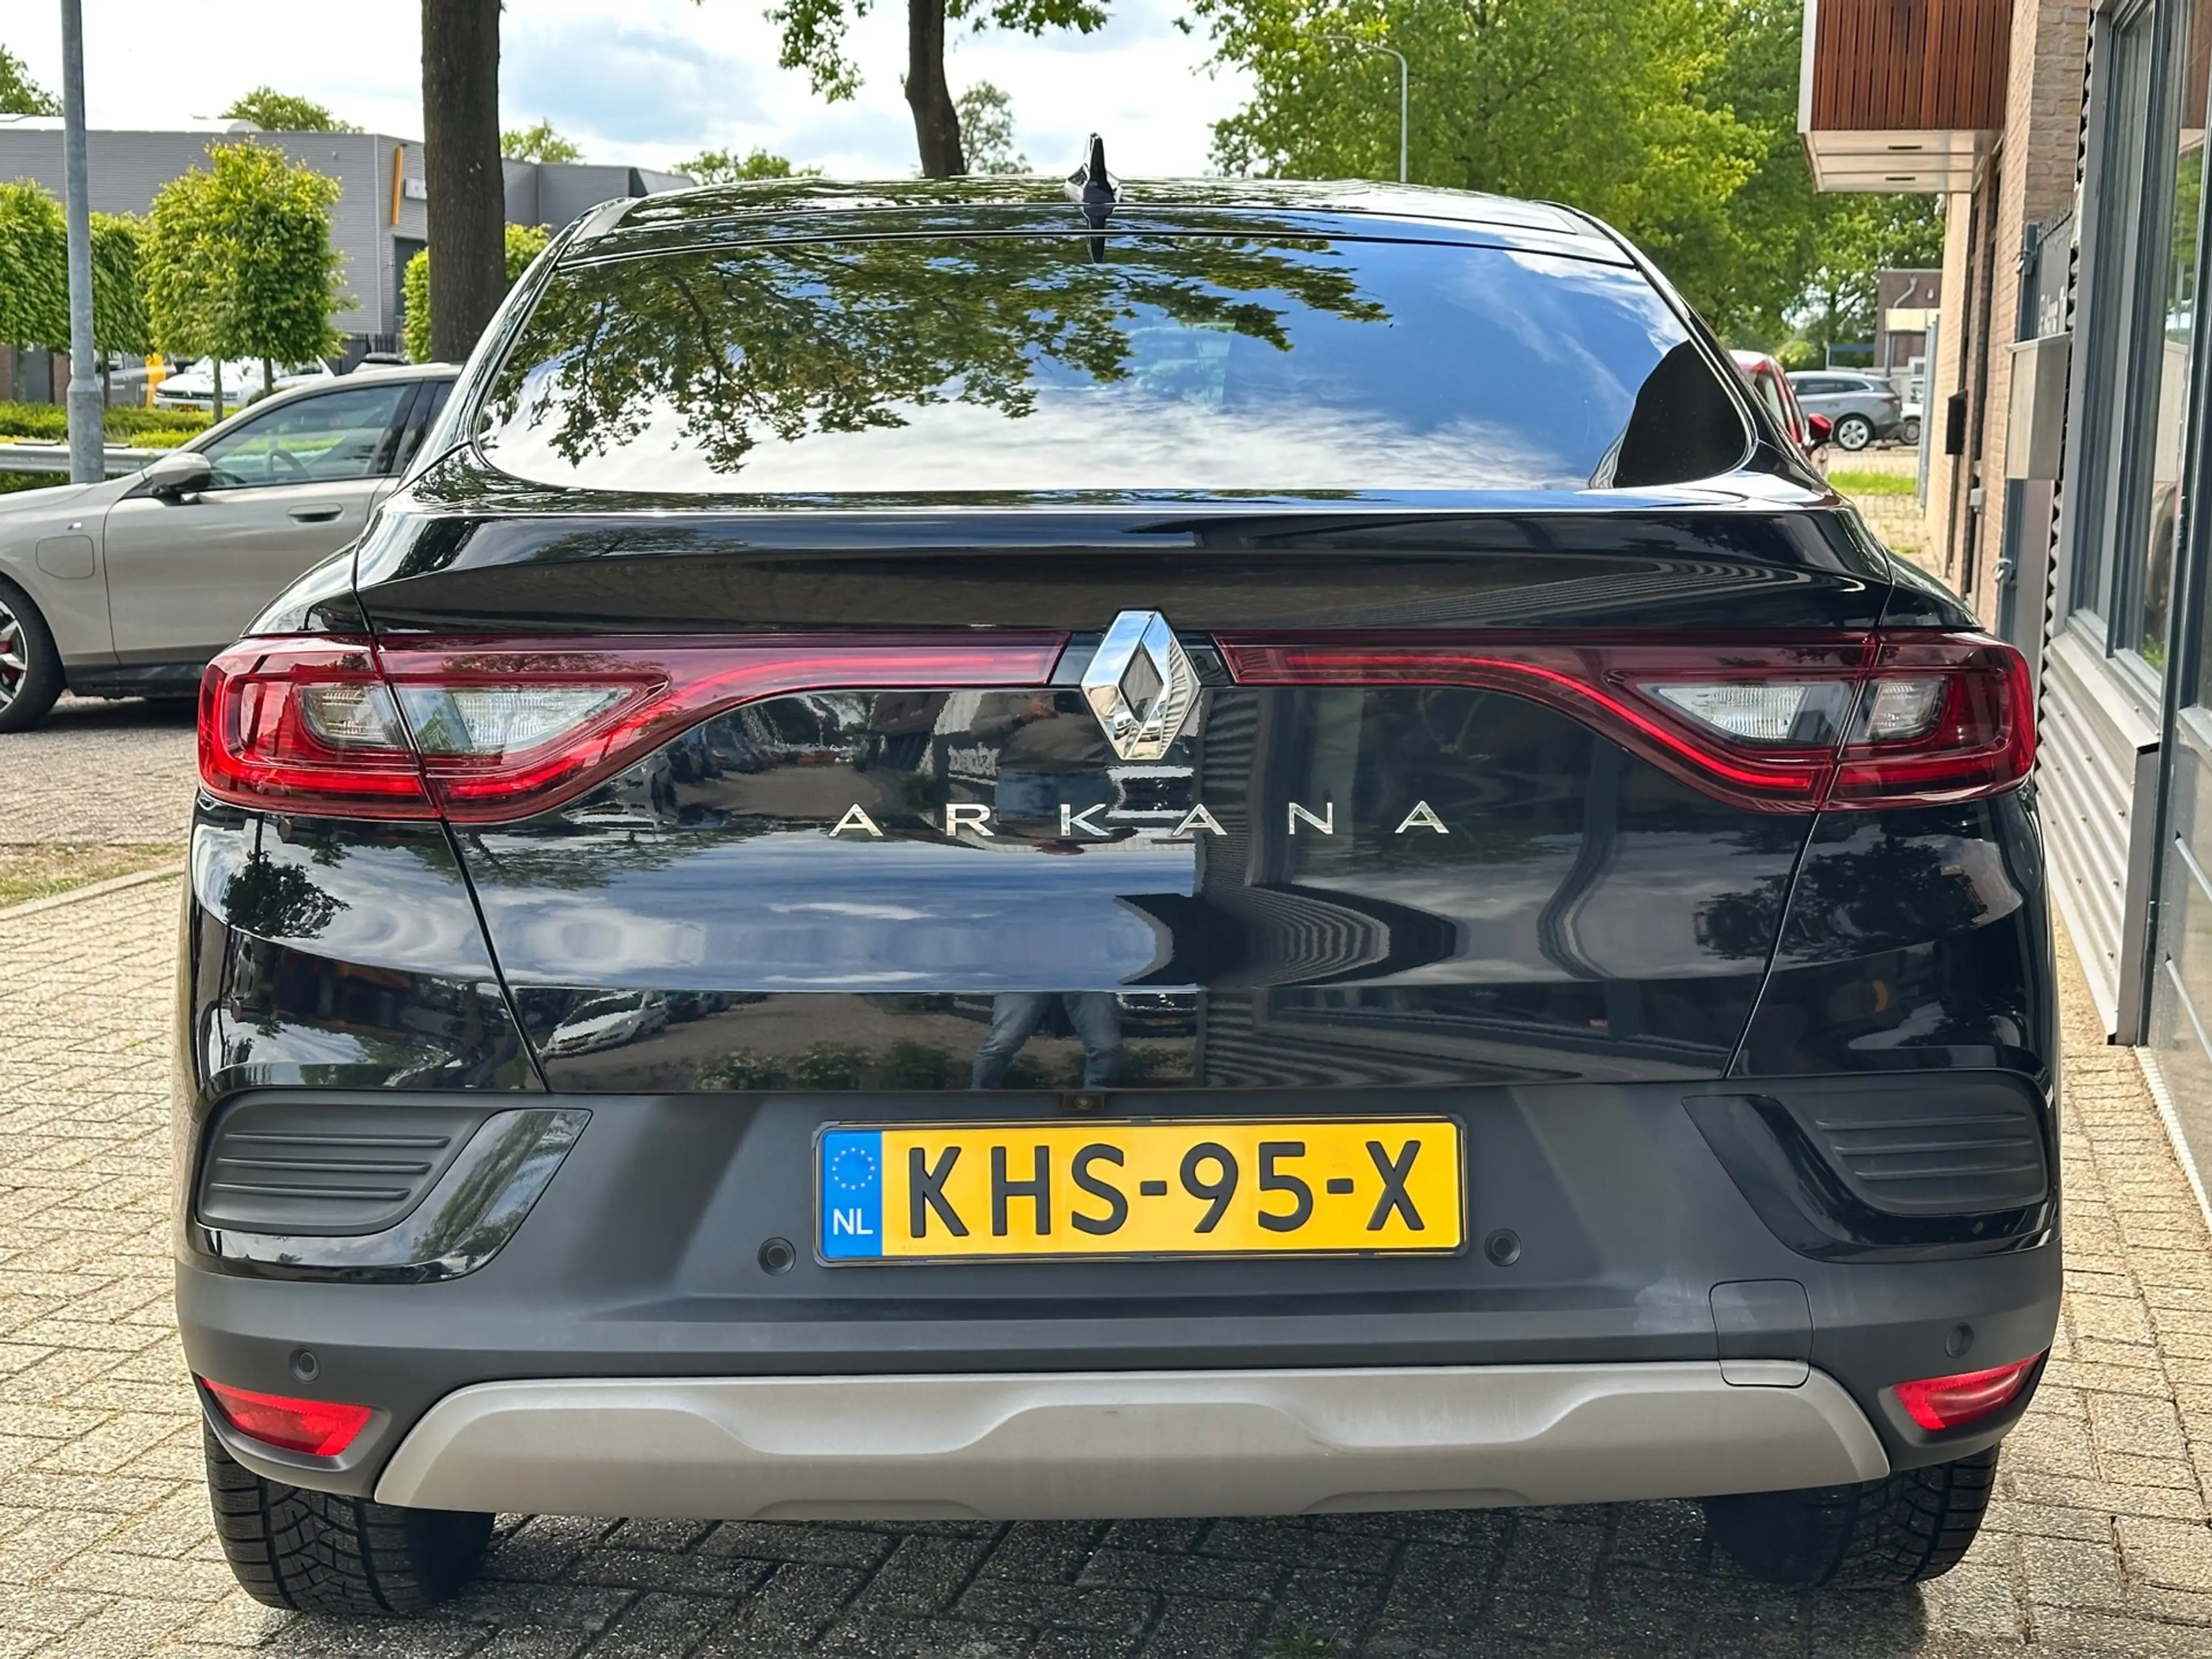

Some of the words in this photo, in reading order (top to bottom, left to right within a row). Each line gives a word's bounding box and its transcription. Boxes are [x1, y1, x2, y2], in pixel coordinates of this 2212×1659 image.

[829, 800, 1450, 837] ARKANA
[908, 1140, 1425, 1238] KHS-95-X
[834, 1208, 873, 1235] NL
